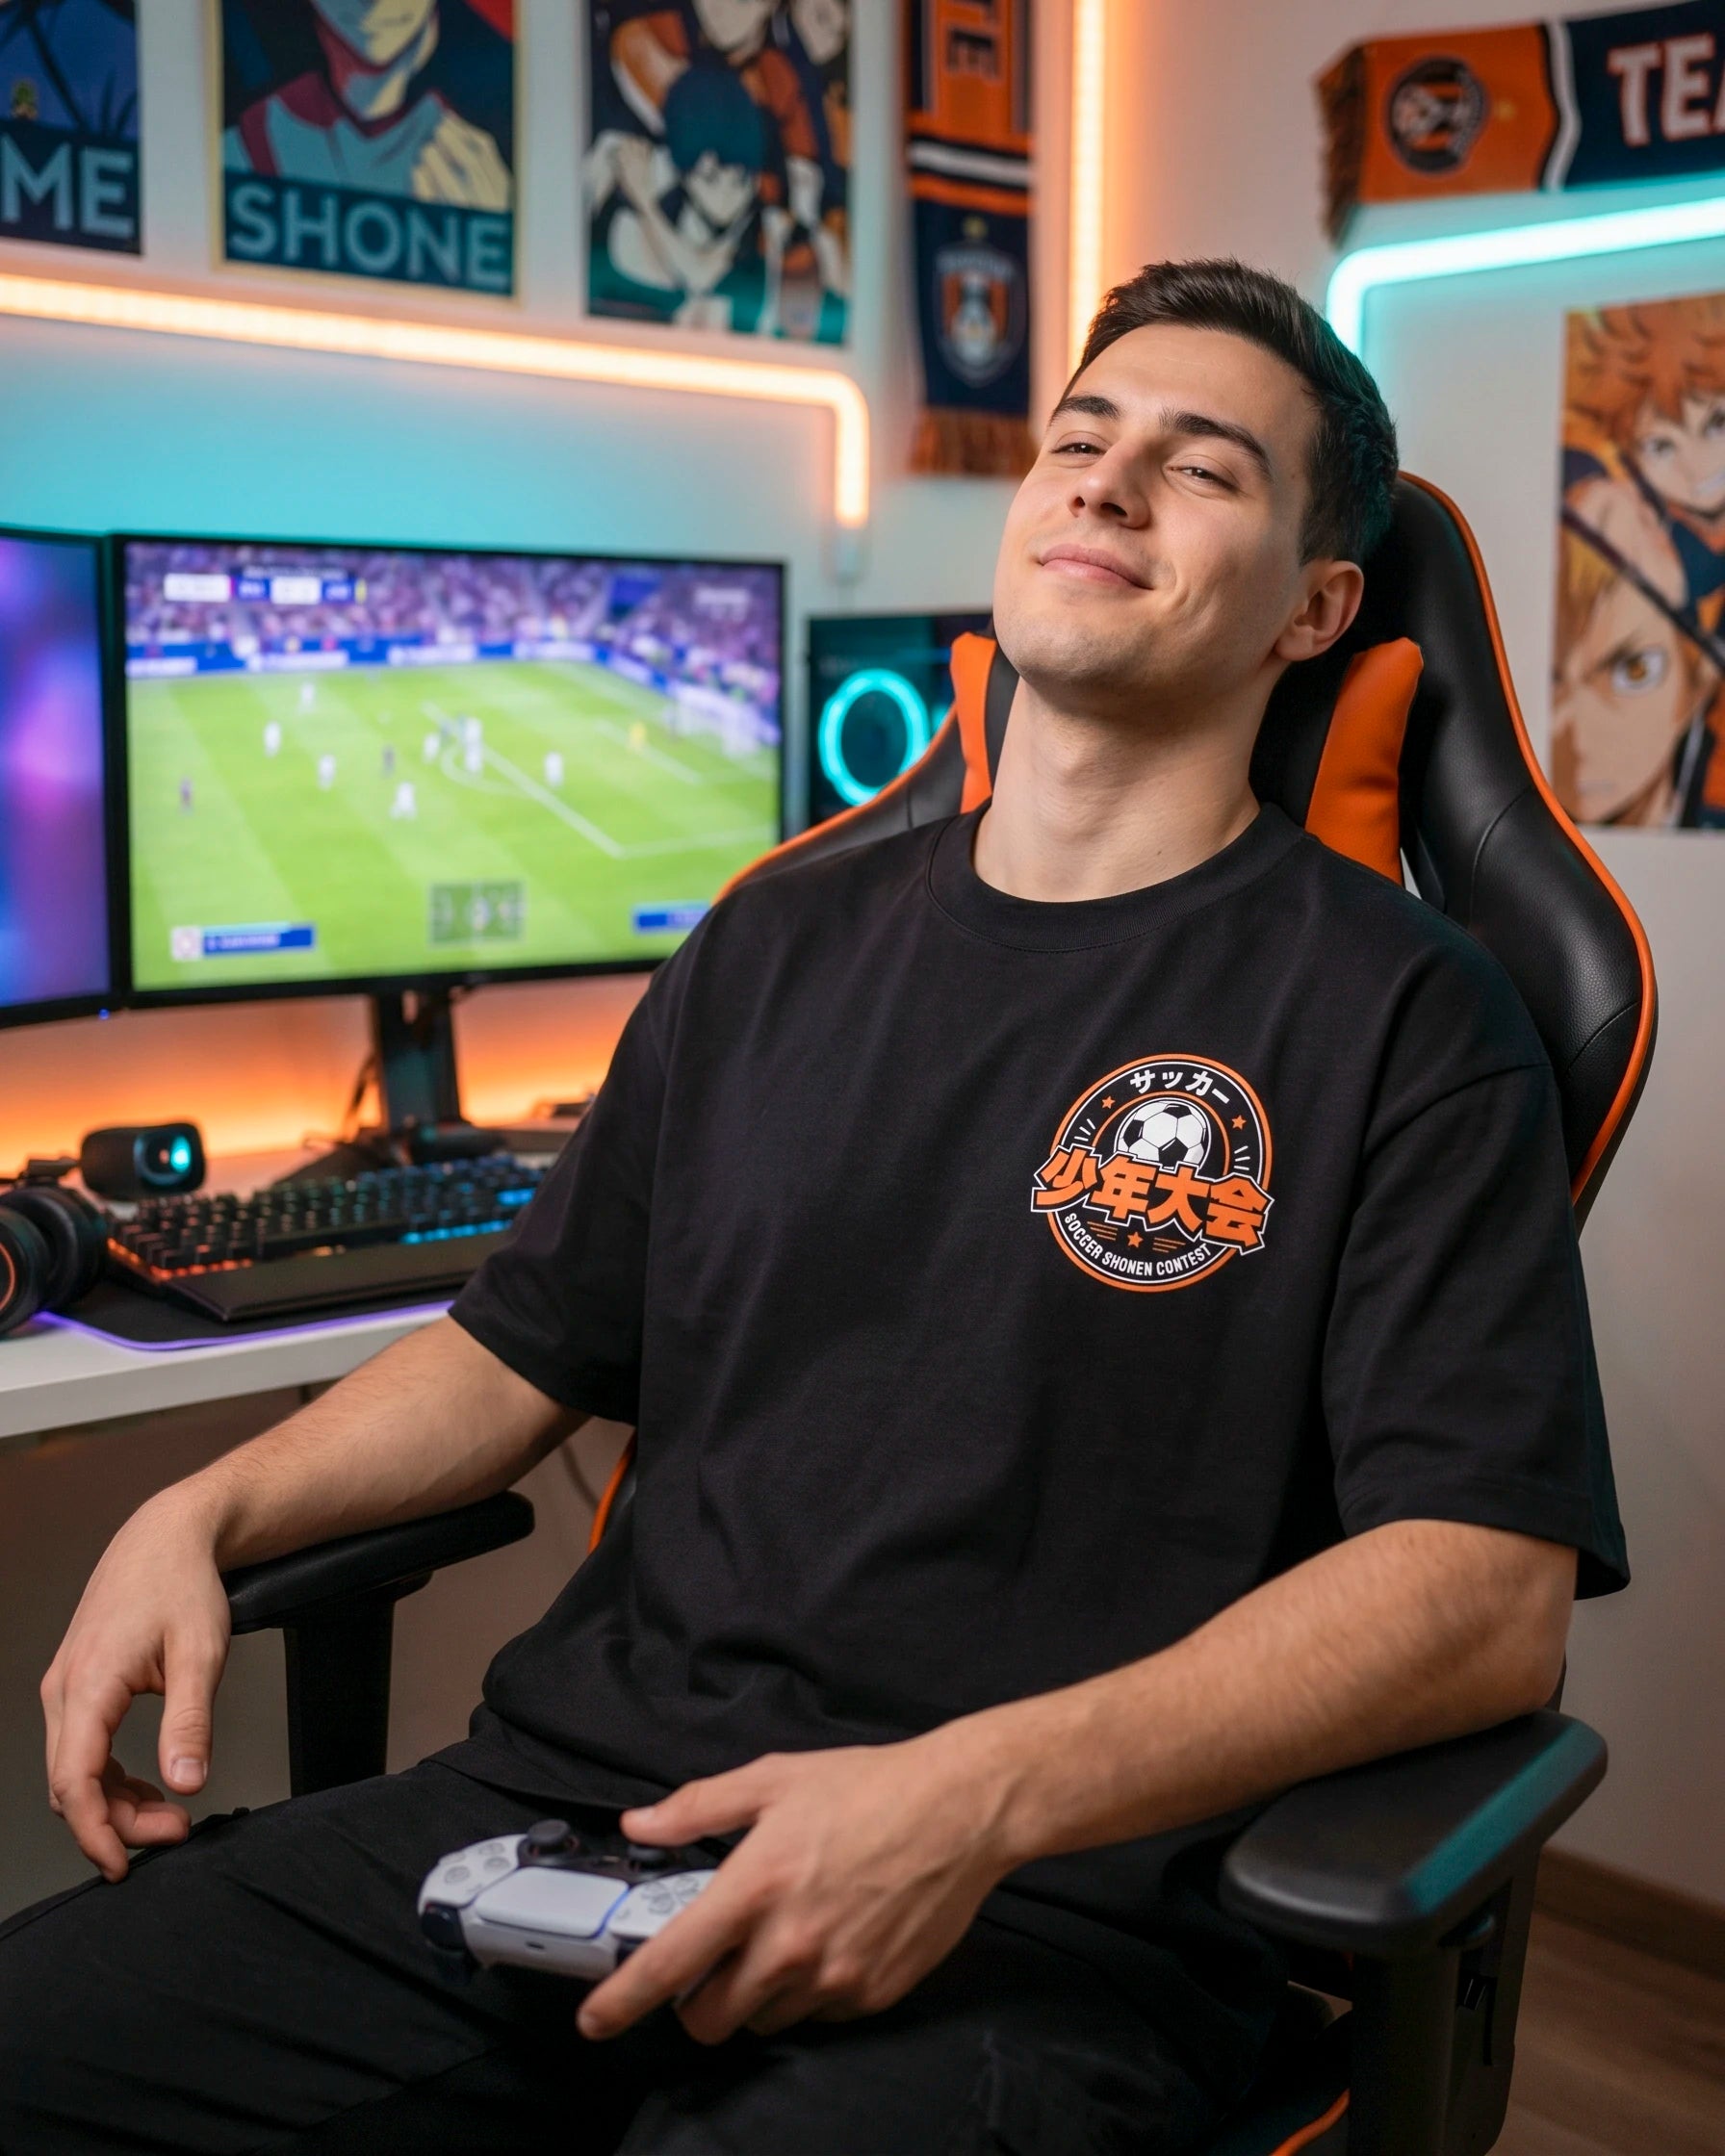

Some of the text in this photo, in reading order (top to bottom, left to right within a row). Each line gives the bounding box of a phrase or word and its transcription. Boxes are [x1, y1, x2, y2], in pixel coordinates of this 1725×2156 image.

[1608, 32, 1725, 147] TE
[0, 133, 134, 239] ME
[229, 182, 511, 287] SHONE
[1130, 1069, 1230, 1104] サッカー
[1035, 1147, 1269, 1248] 少年大会
[1065, 1213, 1212, 1276] SOCCER SHONEN CONTEST
